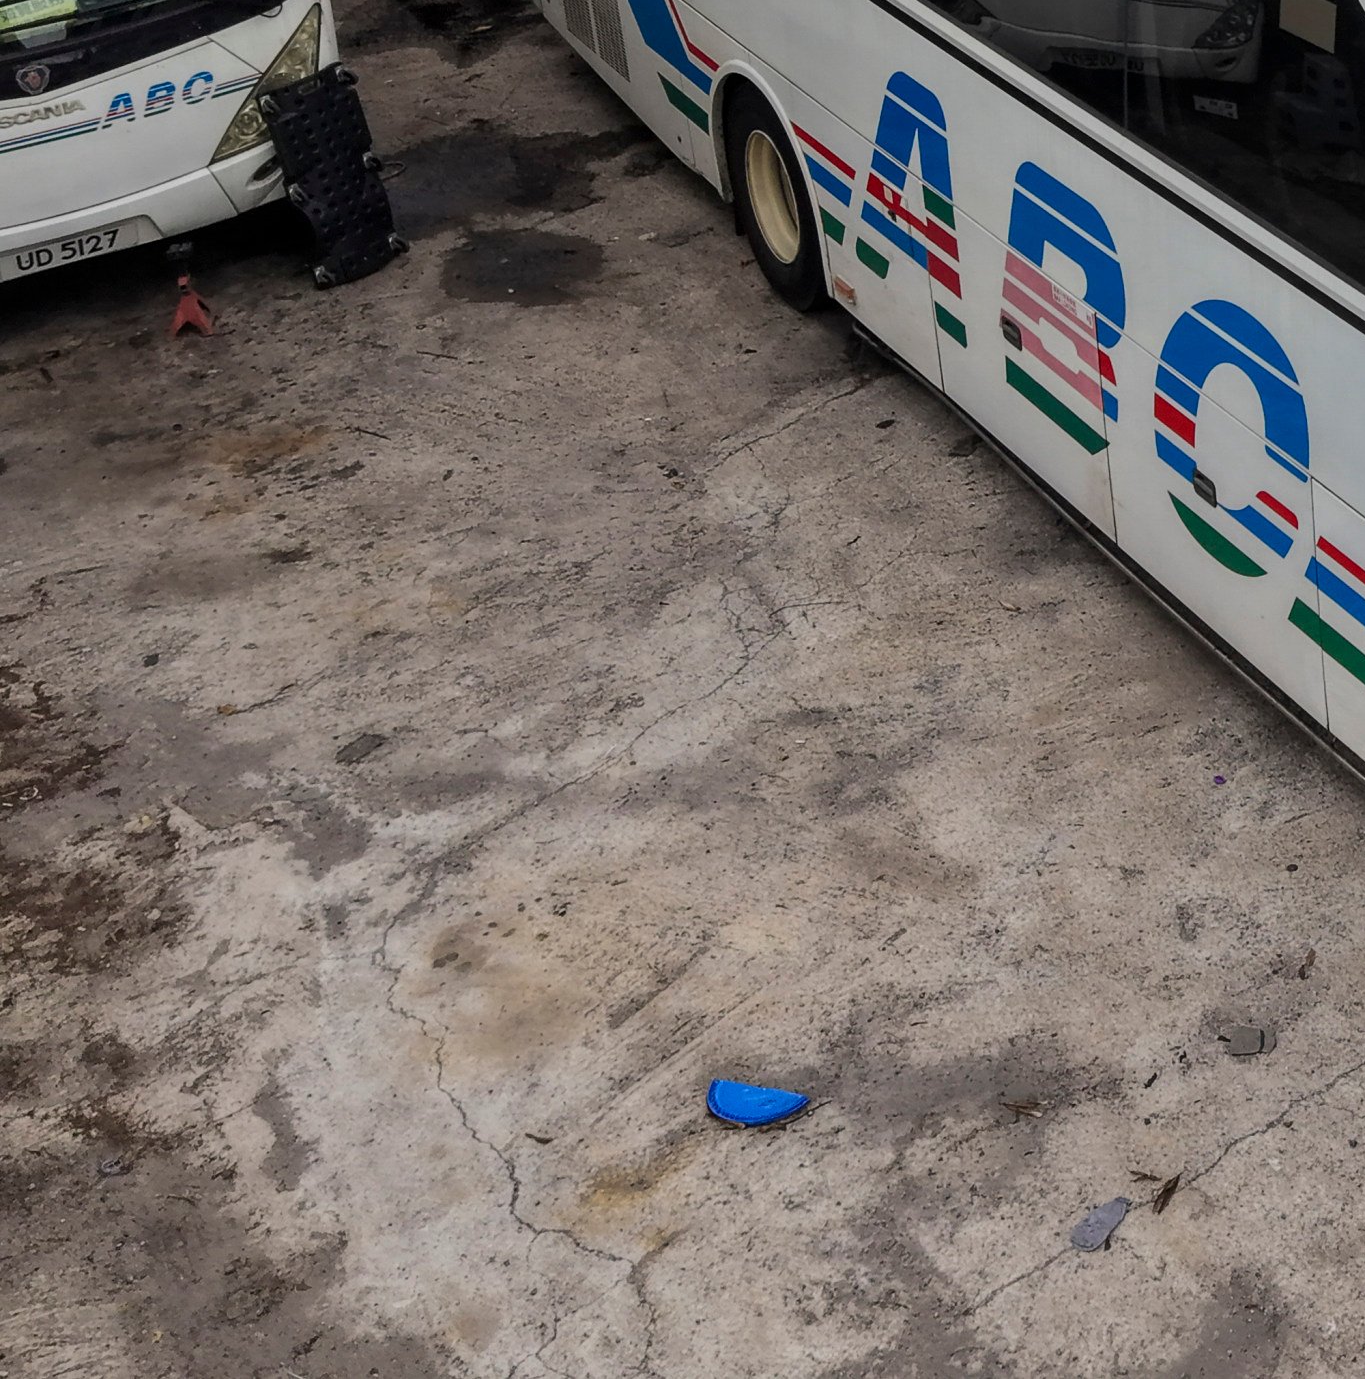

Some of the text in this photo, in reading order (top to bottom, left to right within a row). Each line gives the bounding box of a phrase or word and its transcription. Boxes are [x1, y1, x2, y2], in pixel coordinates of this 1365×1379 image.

[0, 99, 87, 129] SCANIA
[102, 70, 214, 129] ABC
[16, 228, 119, 271] UD 5127
[853, 70, 1310, 577] ABC
